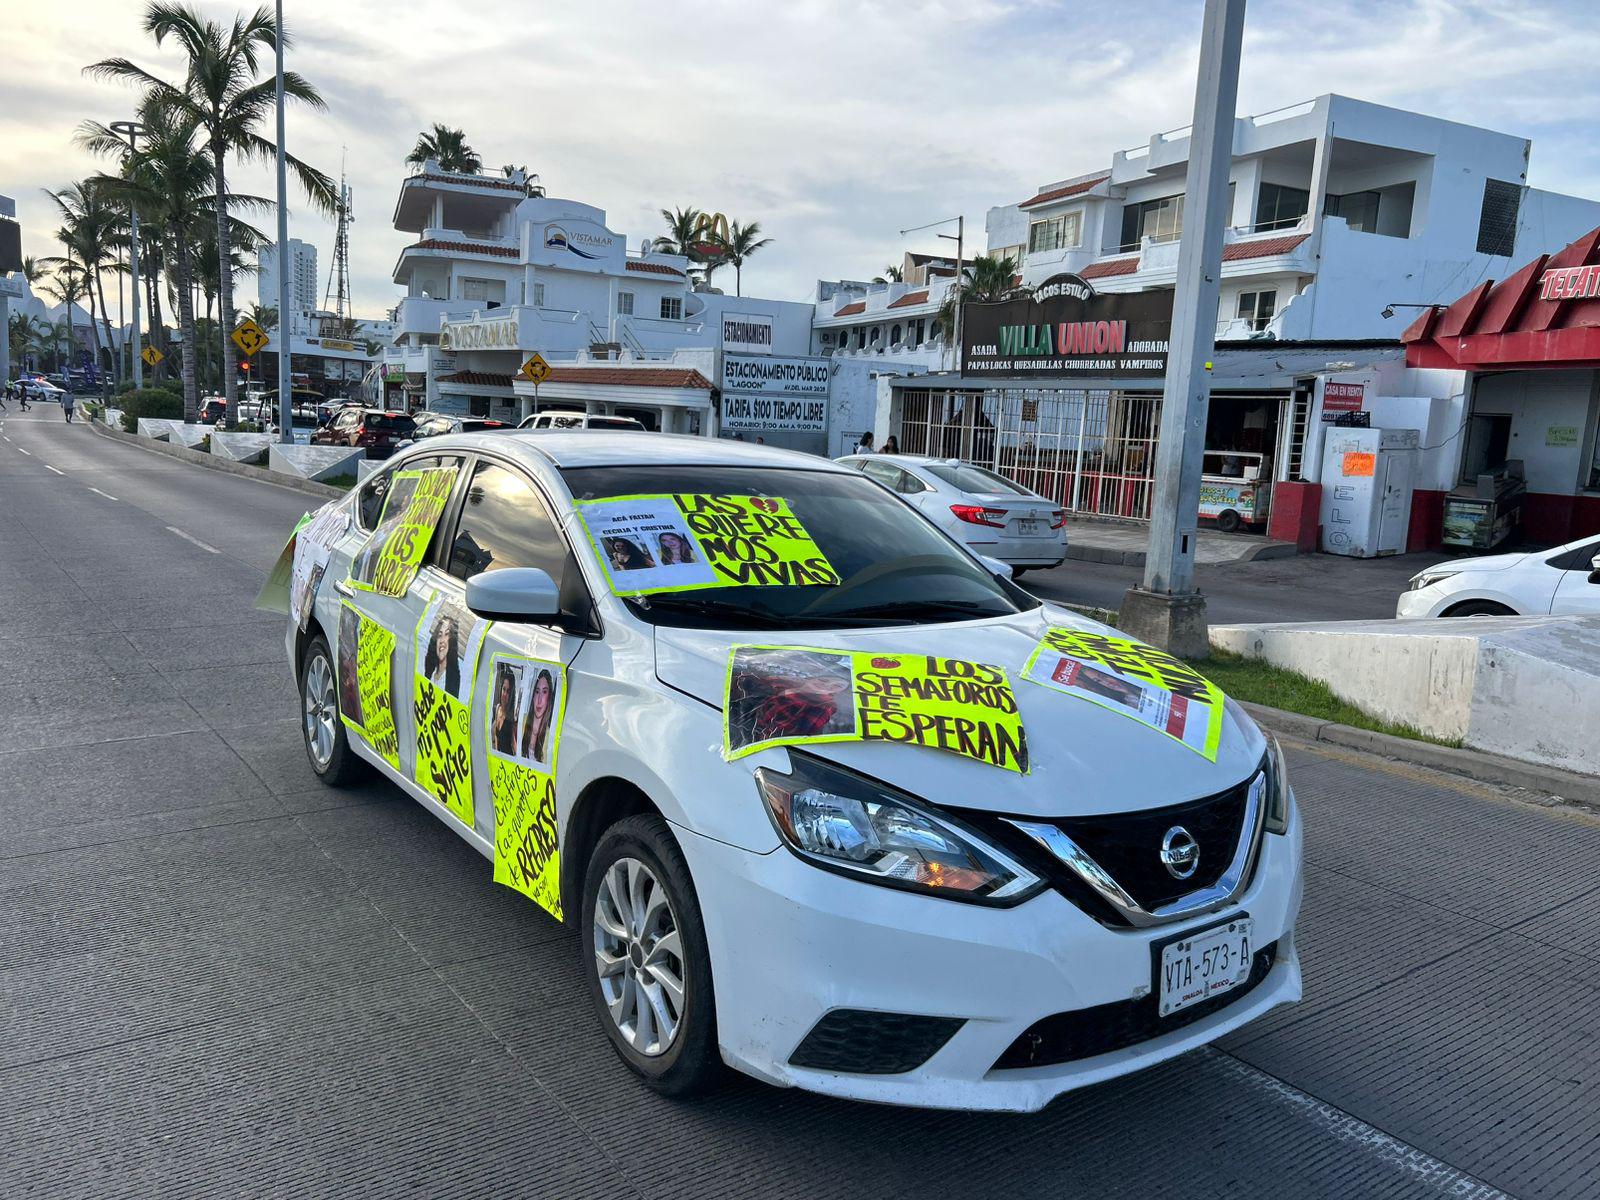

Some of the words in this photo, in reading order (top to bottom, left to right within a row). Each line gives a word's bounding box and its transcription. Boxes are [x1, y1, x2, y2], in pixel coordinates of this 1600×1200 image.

[569, 231, 613, 246] VISTAMAR
[1032, 283, 1061, 304] TACOS
[1060, 283, 1090, 301] ESTILO
[452, 320, 519, 349] VISTAMAR
[724, 320, 772, 346] ESTACIONAMIENTO
[1000, 323, 1053, 356] VILLA
[1057, 319, 1127, 355] UNION
[971, 344, 997, 356] ASADA
[1127, 340, 1169, 353] ADOBADA
[725, 361, 795, 380] ESTACIONAMIENTO
[796, 361, 828, 382] PÚBLICO
[967, 360, 990, 370] PAPAS
[990, 360, 1012, 370] LOCAS
[1013, 360, 1063, 370] QUESADILLAS
[1064, 360, 1116, 370] CHORREADAS
[1120, 359, 1164, 370] VAMPIROS
[1325, 385, 1339, 396] CASA
[1339, 386, 1347, 397] EN
[1347, 386, 1363, 397] RENTA
[724, 398, 751, 419] TARIFA
[753, 398, 771, 420] $100
[773, 400, 802, 420] TIEMPO
[803, 402, 824, 421] LIBRE
[728, 421, 762, 429] HORARIO:
[762, 421, 777, 429] 9:00
[673, 494, 748, 516] LAS
[628, 513, 656, 522] FALTAN
[687, 512, 810, 541] QUERE
[602, 527, 632, 535] CECILIA
[640, 524, 676, 532] CRISTINA
[698, 534, 780, 565] MOS
[714, 557, 841, 585] VIVAS
[926, 655, 1004, 685] LOS
[852, 691, 904, 711] TE
[855, 671, 1018, 715] SEMAFOROS
[430, 693, 453, 760] papi
[857, 707, 1029, 774] ESPERAN
